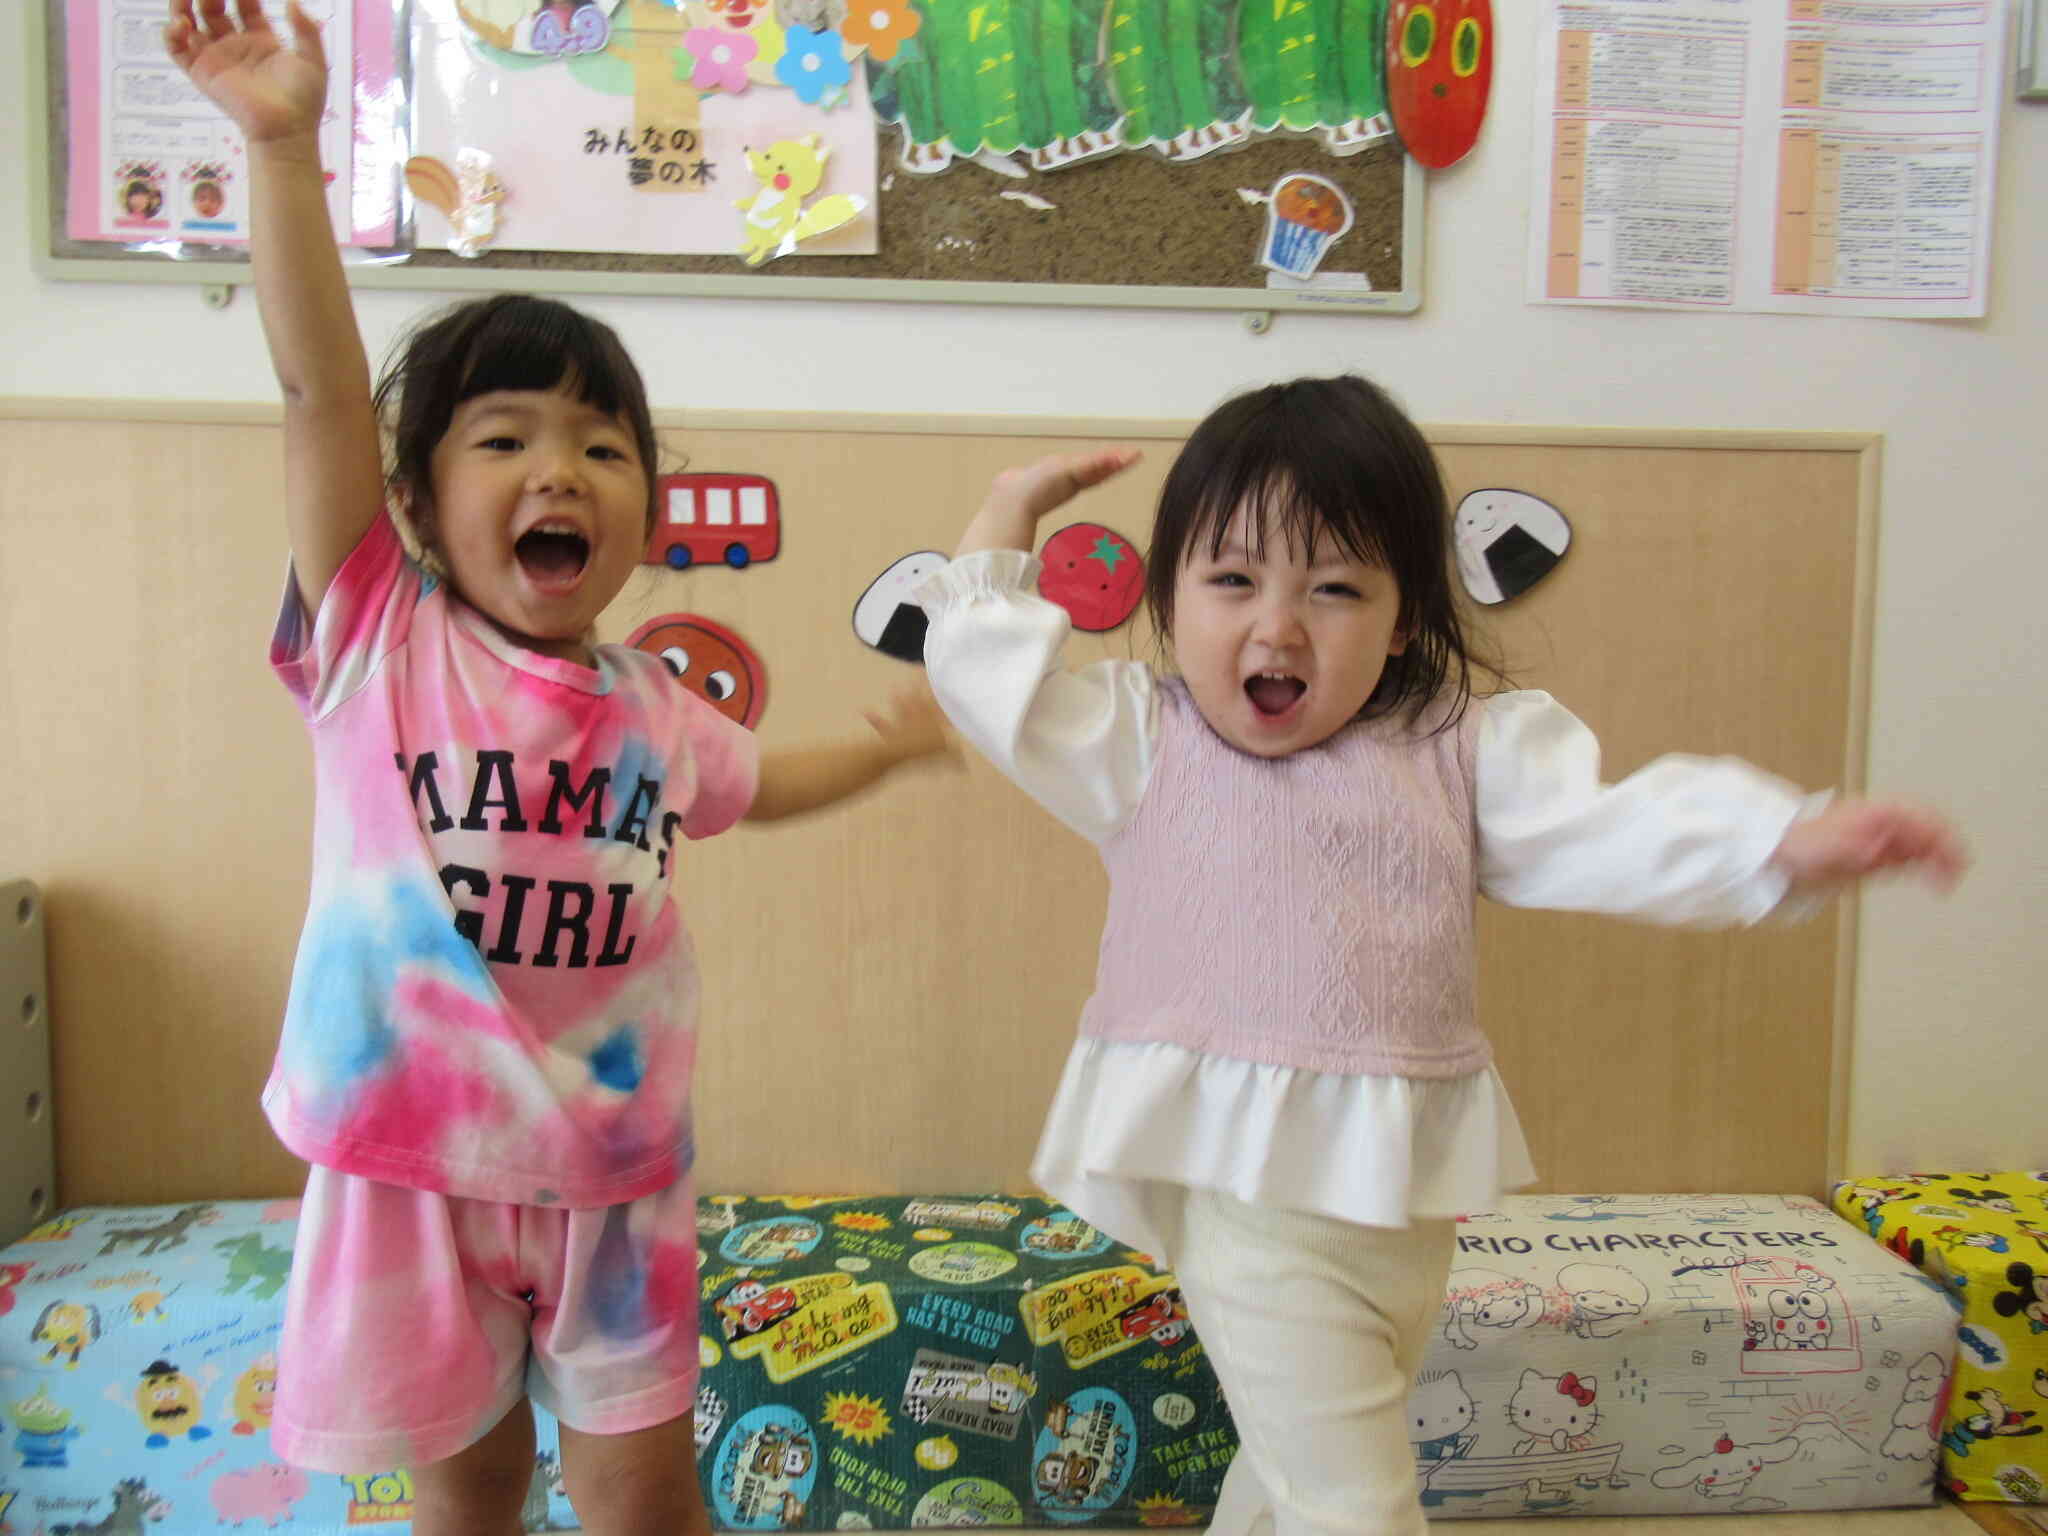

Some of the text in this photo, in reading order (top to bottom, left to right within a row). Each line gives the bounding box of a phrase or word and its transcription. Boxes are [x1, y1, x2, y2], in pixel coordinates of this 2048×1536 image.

[583, 126, 697, 154] みんなの
[628, 157, 718, 186] 夢の木
[438, 863, 637, 968] GIRL
[1457, 1231, 1839, 1255] RIO CHARACTERS
[906, 1305, 1001, 1349] HAS A STORY
[974, 1308, 1015, 1335] ROAD
[1152, 1427, 1228, 1465] TAKE THE
[1167, 1444, 1239, 1479] OPEN ROA
